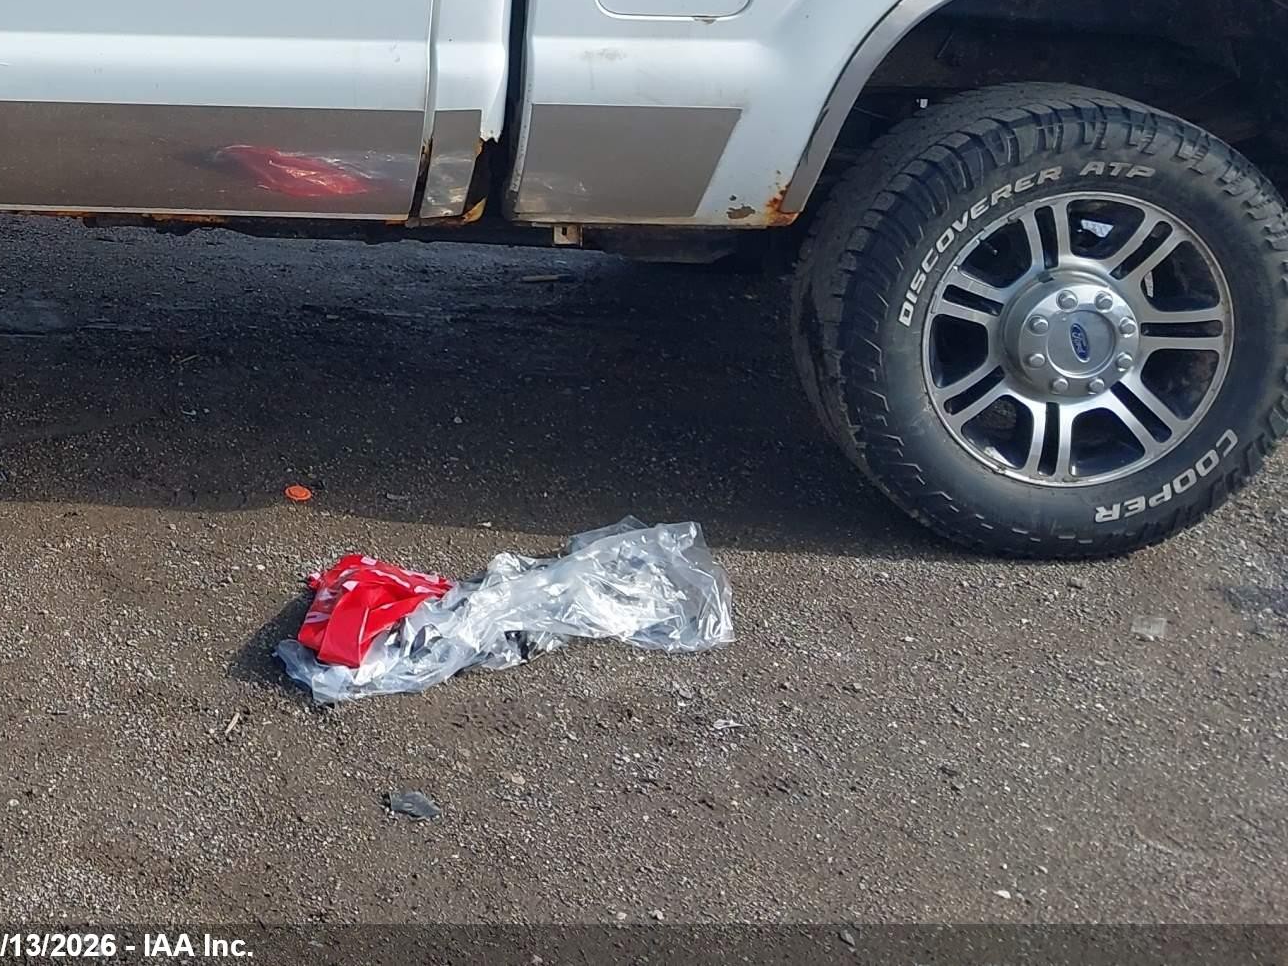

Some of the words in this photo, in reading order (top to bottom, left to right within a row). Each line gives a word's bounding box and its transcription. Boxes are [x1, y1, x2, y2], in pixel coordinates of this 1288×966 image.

[898, 165, 1063, 328] DISCOVERER
[1079, 161, 1156, 180] ATP
[1094, 428, 1239, 523] COOPER
